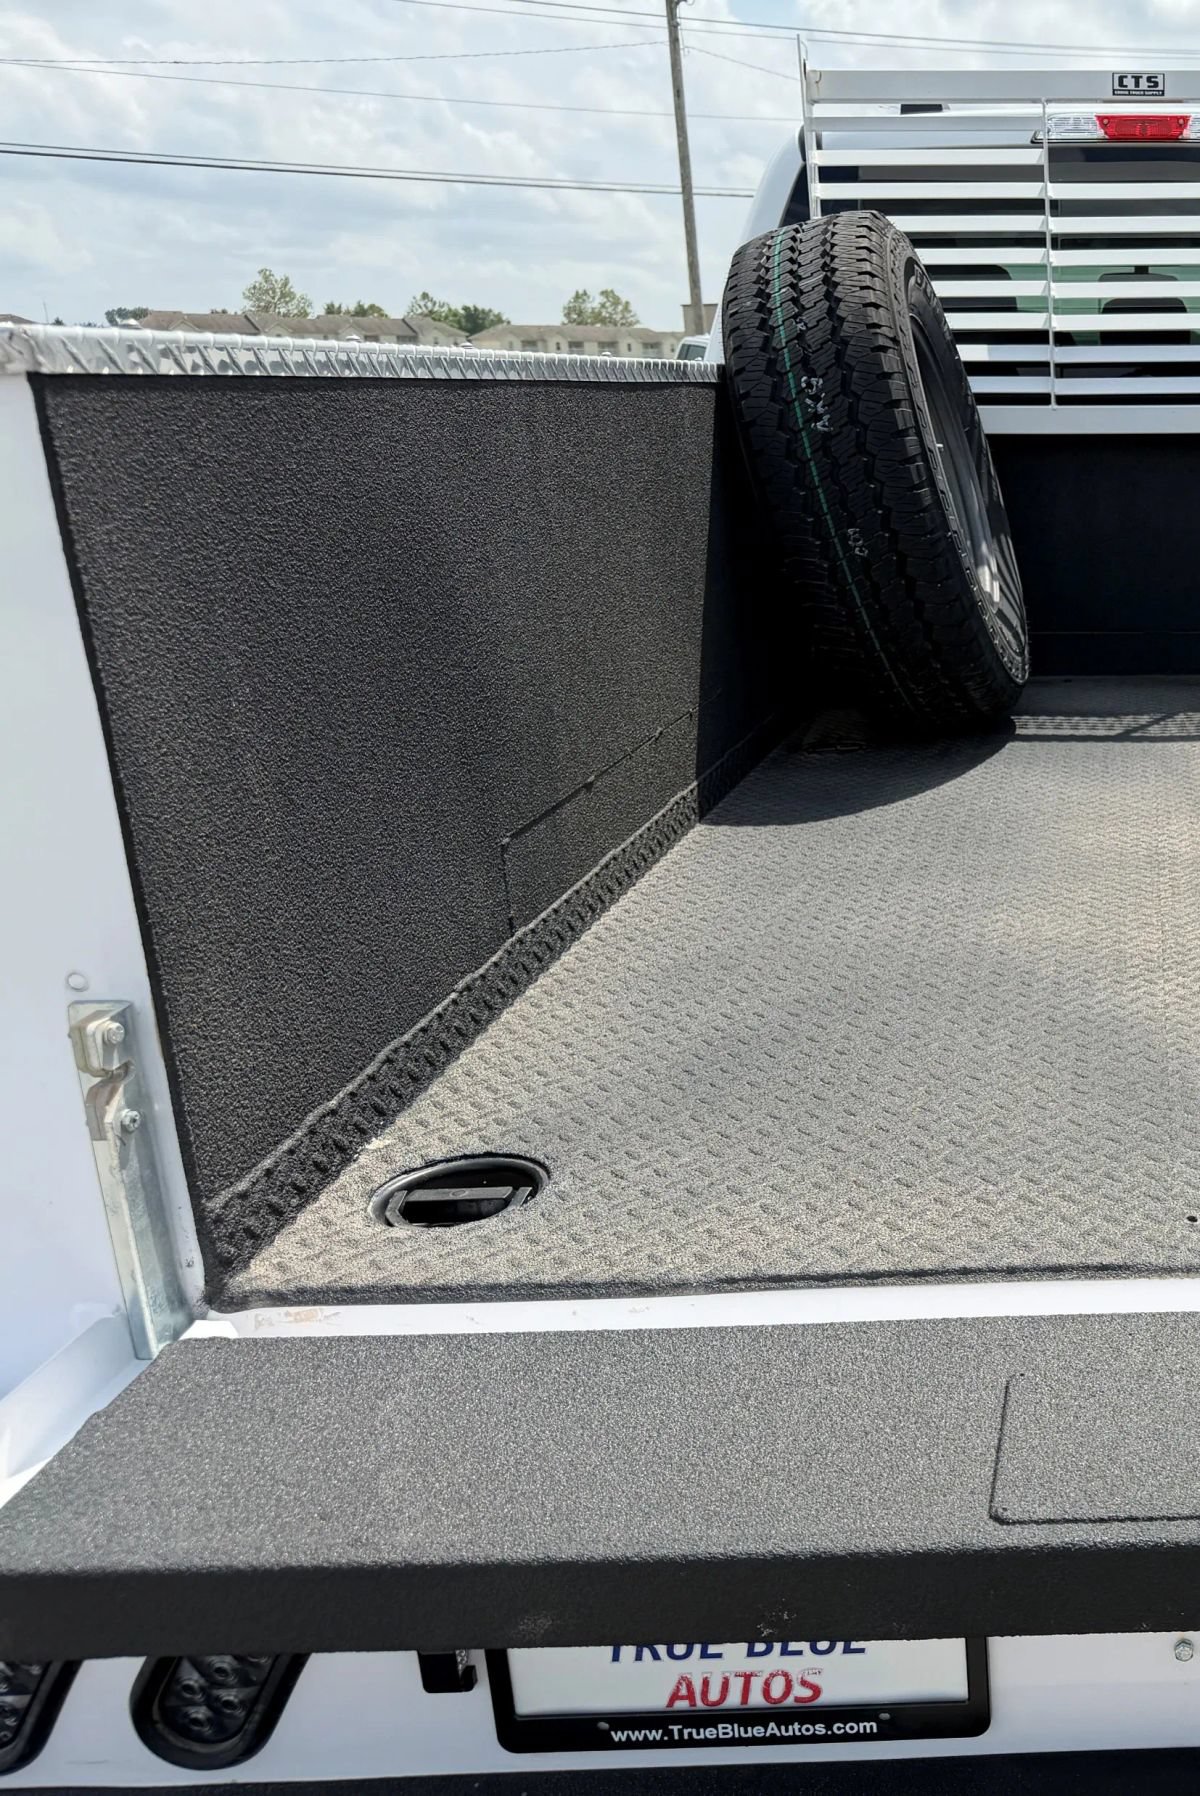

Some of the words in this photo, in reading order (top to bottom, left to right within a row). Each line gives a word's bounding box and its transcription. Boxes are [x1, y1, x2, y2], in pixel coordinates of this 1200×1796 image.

[1117, 74, 1160, 89] CTS
[665, 1668, 823, 1708] AUTOS
[611, 1721, 878, 1742] www.TrueBlueAutos.com
